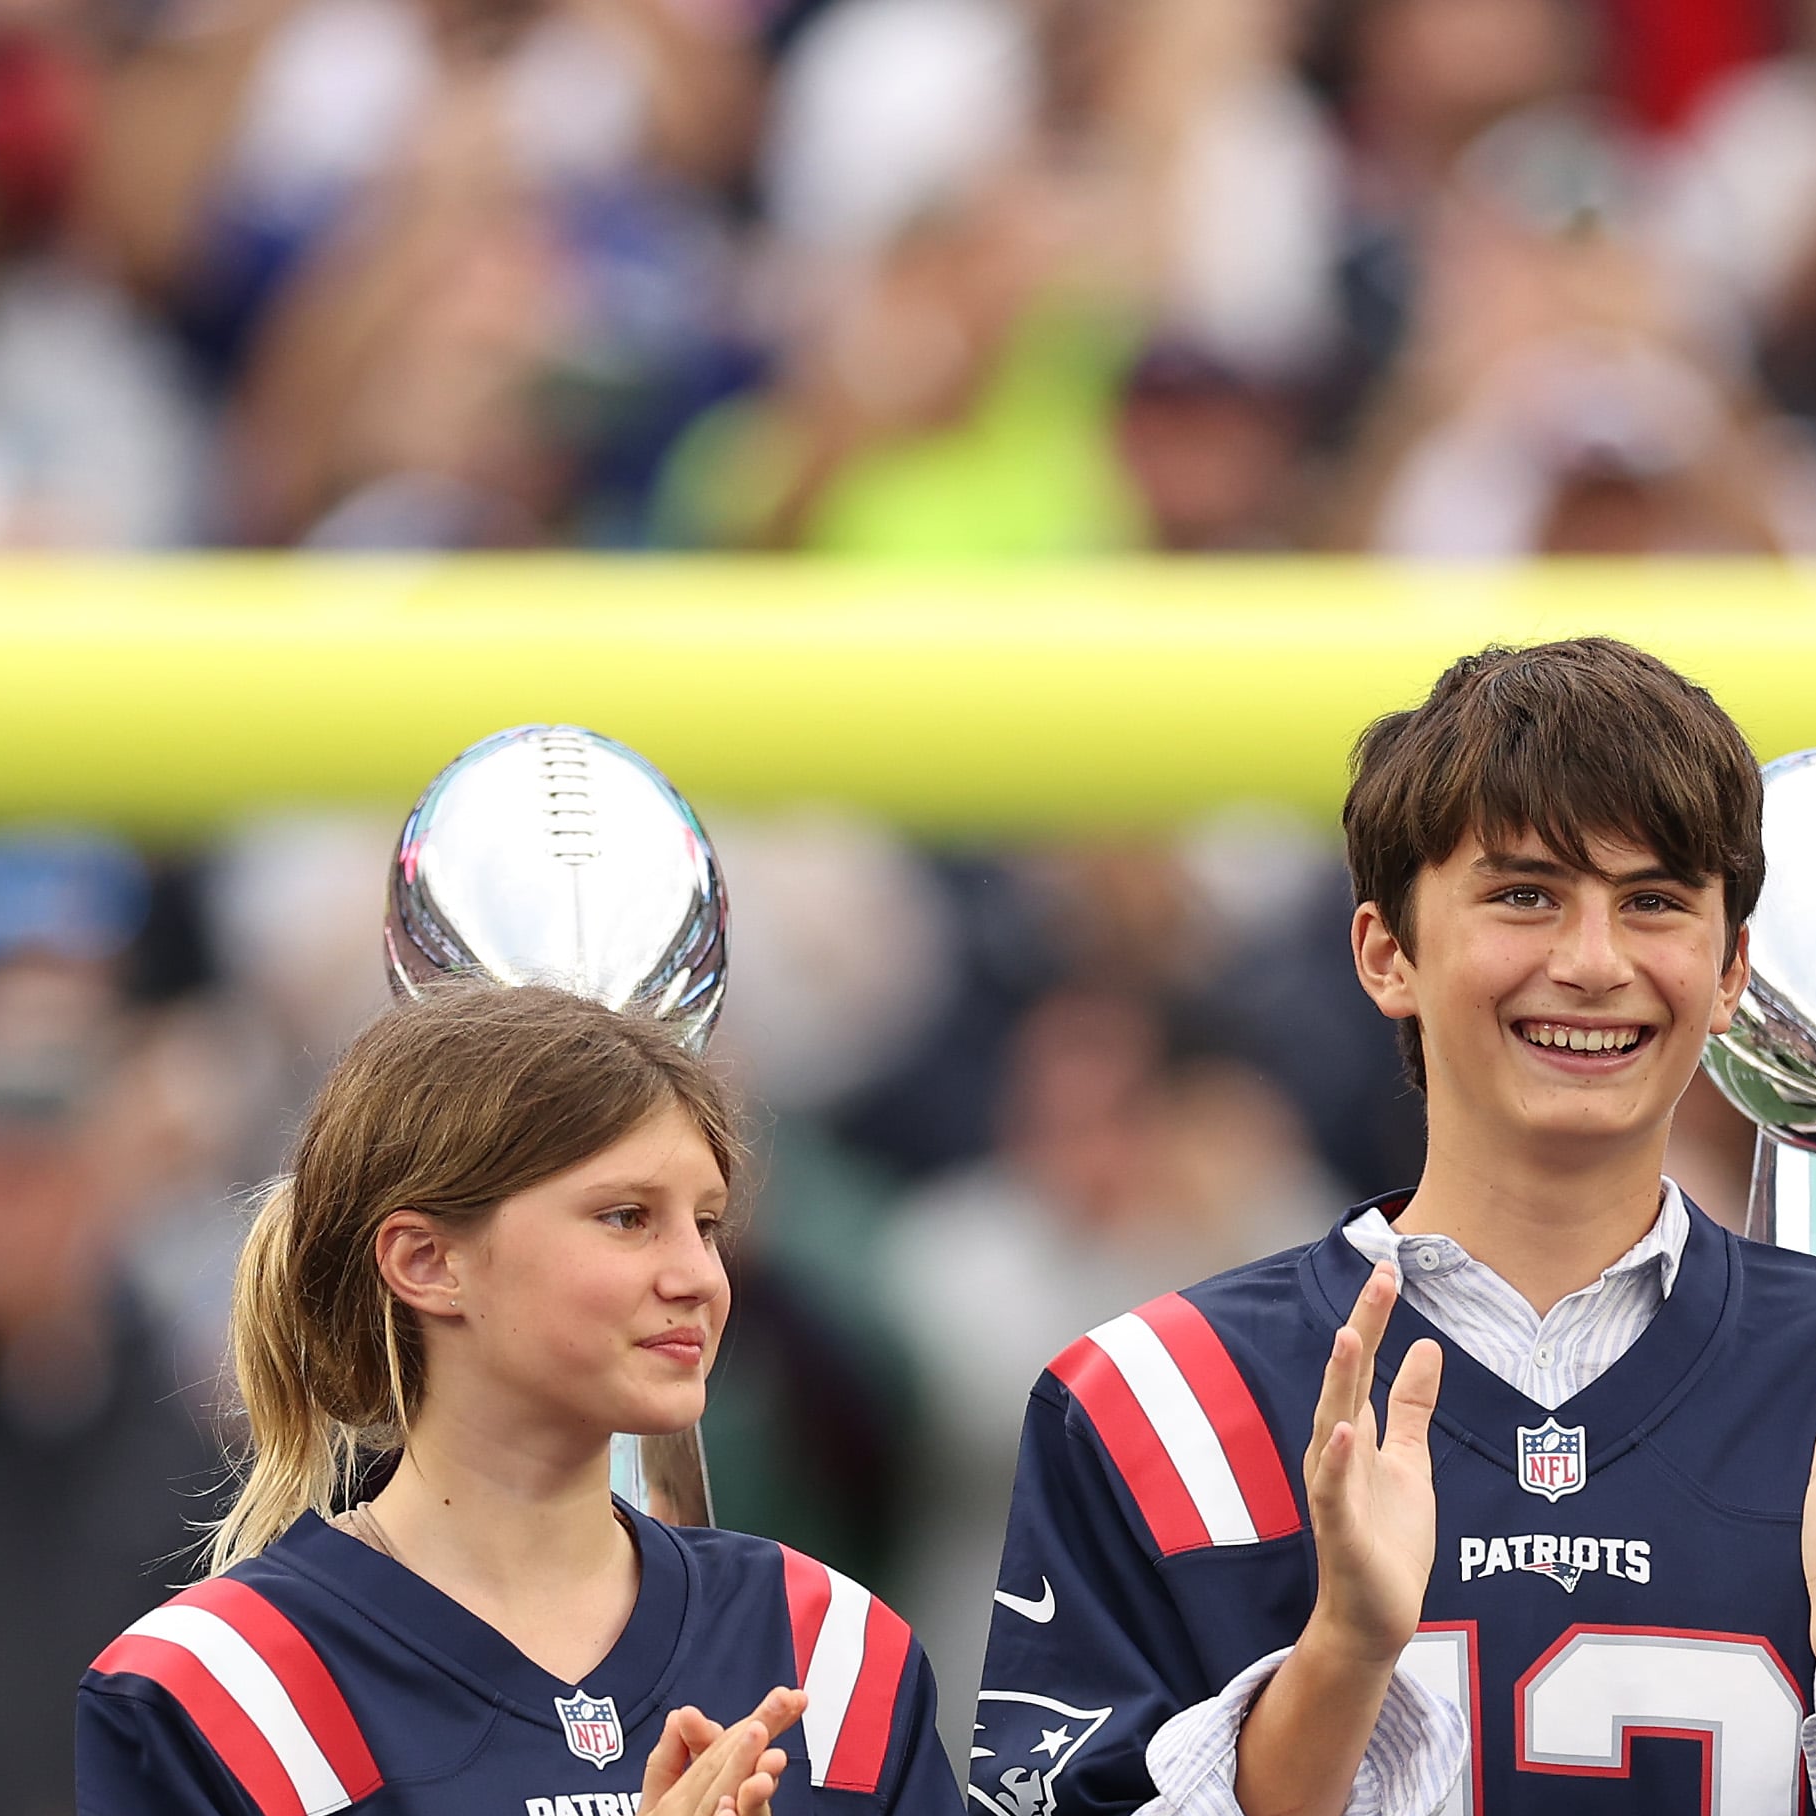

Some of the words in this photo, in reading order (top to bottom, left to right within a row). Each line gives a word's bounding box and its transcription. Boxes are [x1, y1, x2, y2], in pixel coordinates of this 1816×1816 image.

[1529, 1455, 1576, 1487] NFL
[1459, 1533, 1651, 1585] PATRIOTS
[573, 1723, 616, 1754] NFL
